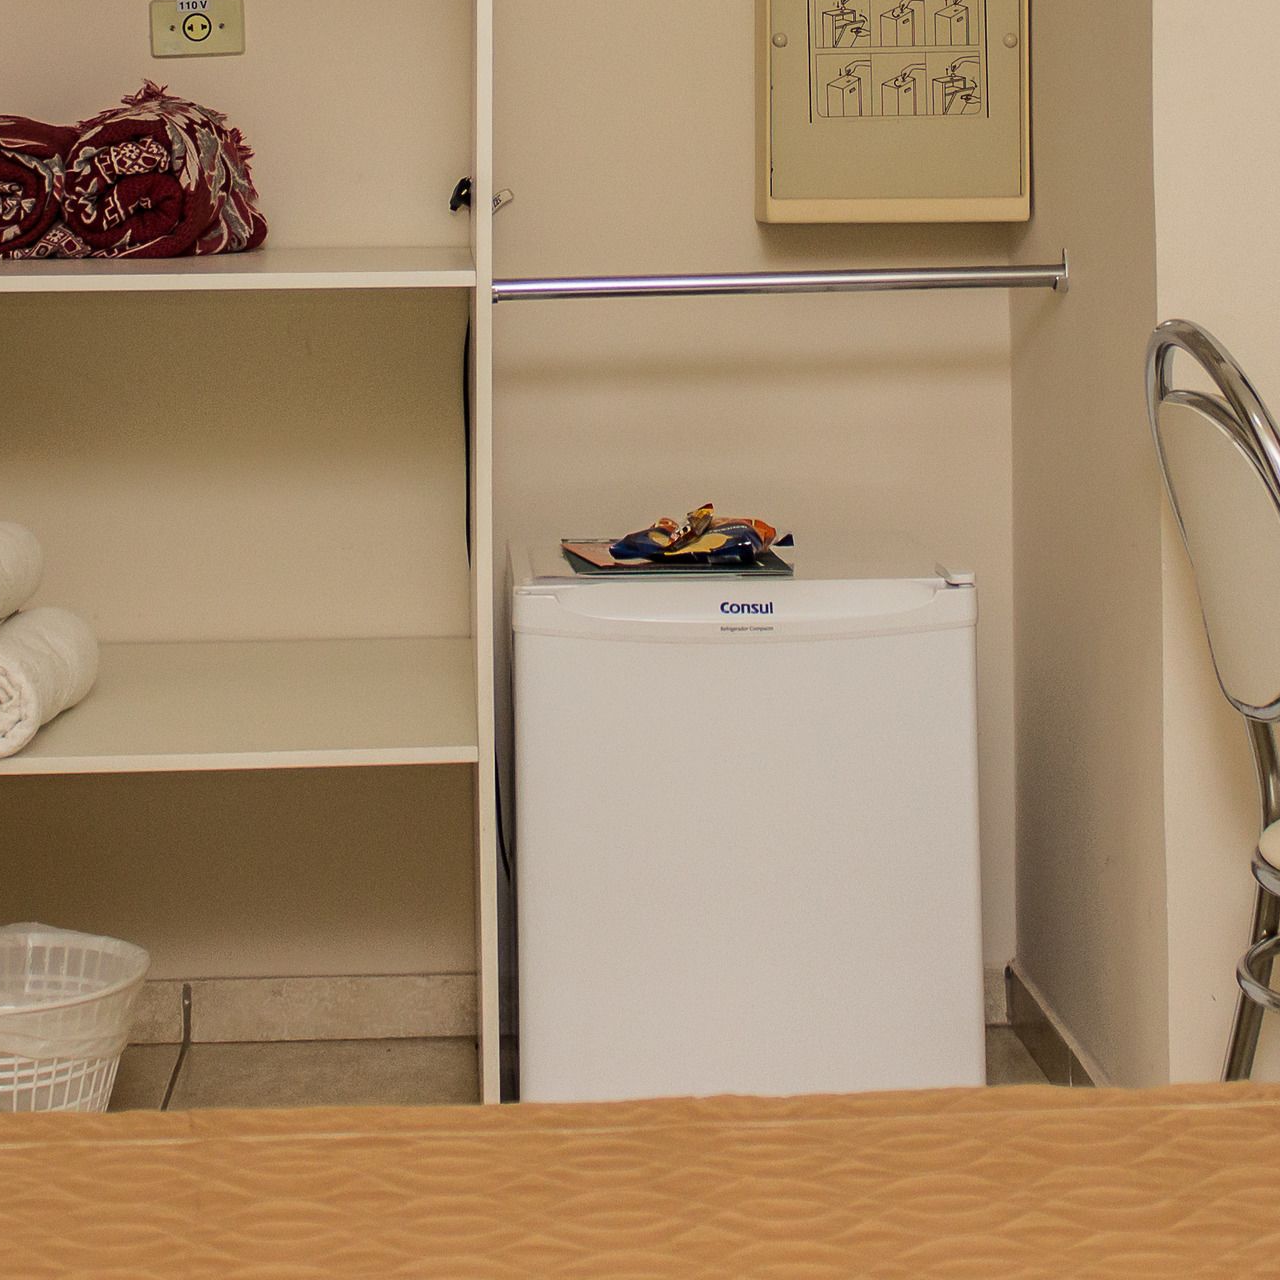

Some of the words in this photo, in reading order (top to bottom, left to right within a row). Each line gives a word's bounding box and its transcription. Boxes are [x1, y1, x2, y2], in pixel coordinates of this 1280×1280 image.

[179, 0, 198, 10] 110
[200, 0, 208, 9] V
[720, 601, 774, 614] Consul
